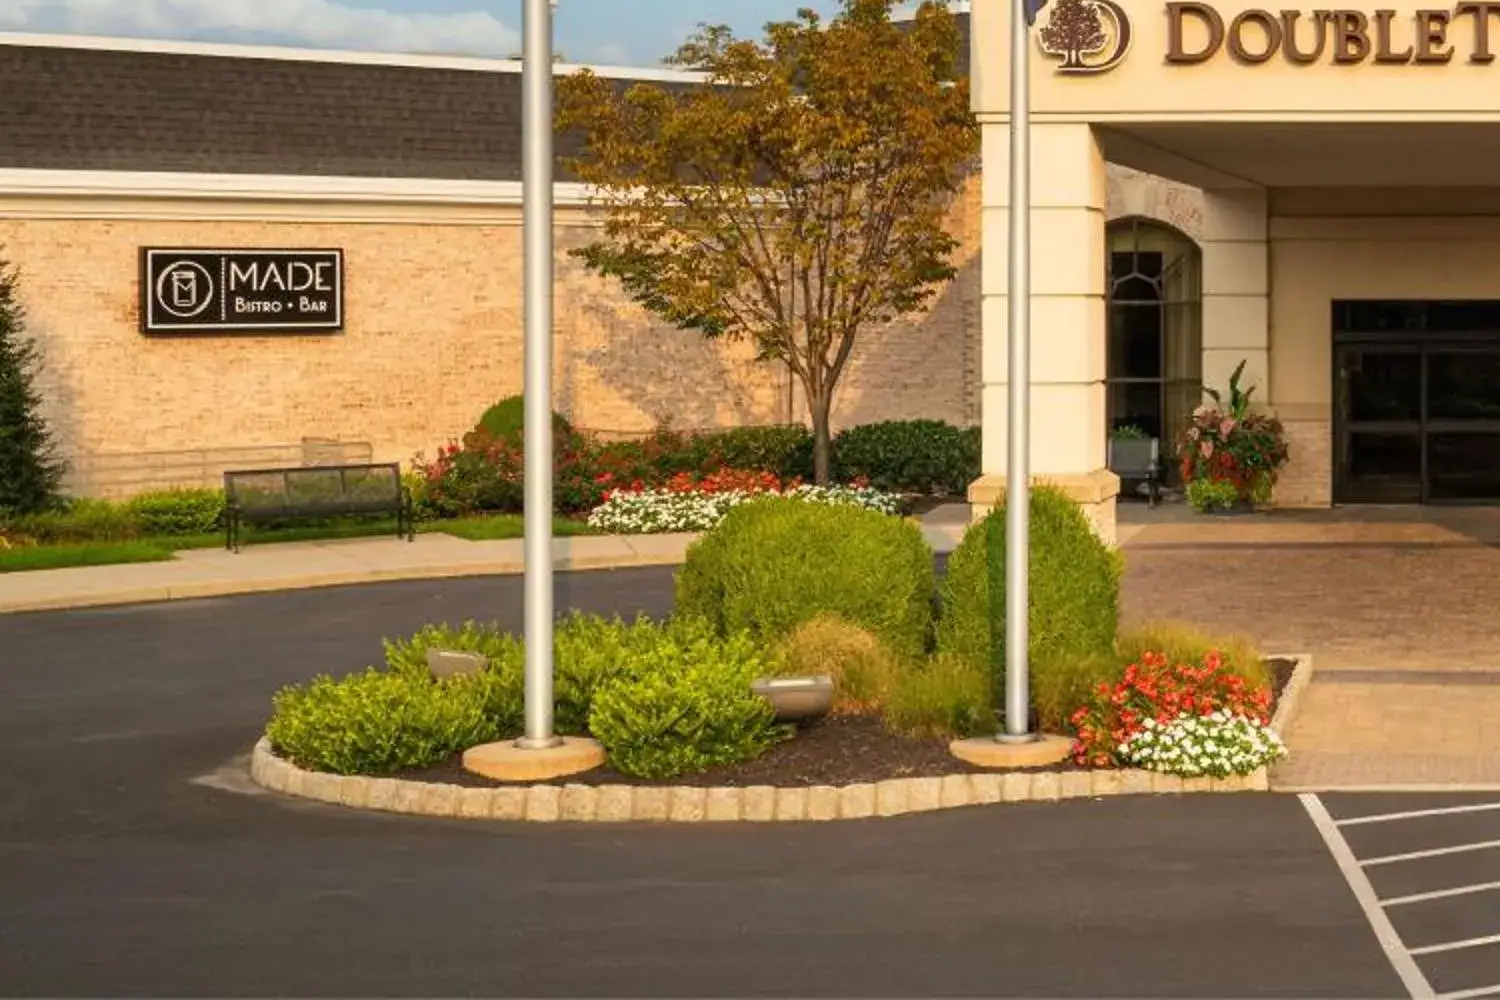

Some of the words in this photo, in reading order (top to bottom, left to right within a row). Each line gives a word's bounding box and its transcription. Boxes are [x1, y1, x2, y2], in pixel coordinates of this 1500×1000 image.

[229, 261, 332, 291] MADE
[234, 296, 282, 313] BISTRO
[299, 296, 328, 313] BAR
